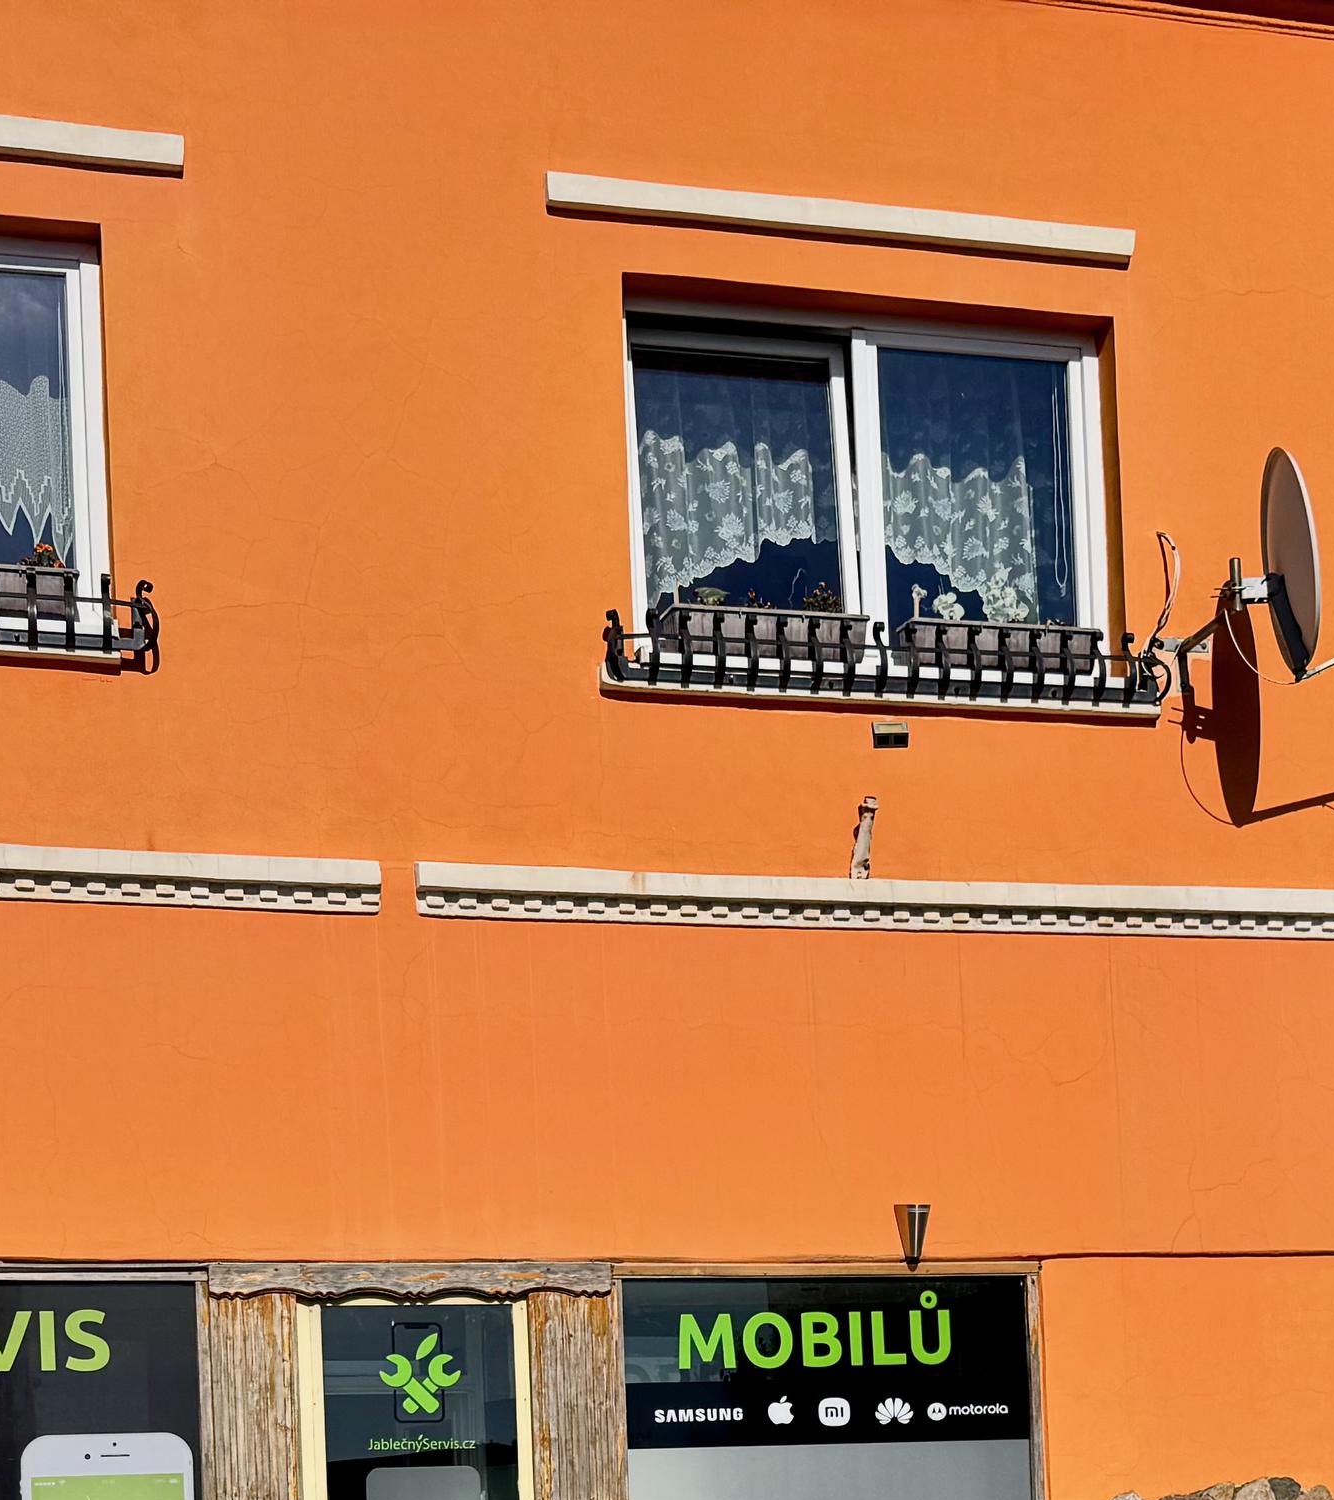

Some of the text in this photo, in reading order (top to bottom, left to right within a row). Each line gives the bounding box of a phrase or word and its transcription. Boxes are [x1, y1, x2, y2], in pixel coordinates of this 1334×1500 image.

[678, 1290, 952, 1370] MOBILŮ
[654, 1407, 744, 1423] SAMSUNG
[948, 1403, 1009, 1416] motorola
[368, 1434, 476, 1453] JablečnýServis.cz
